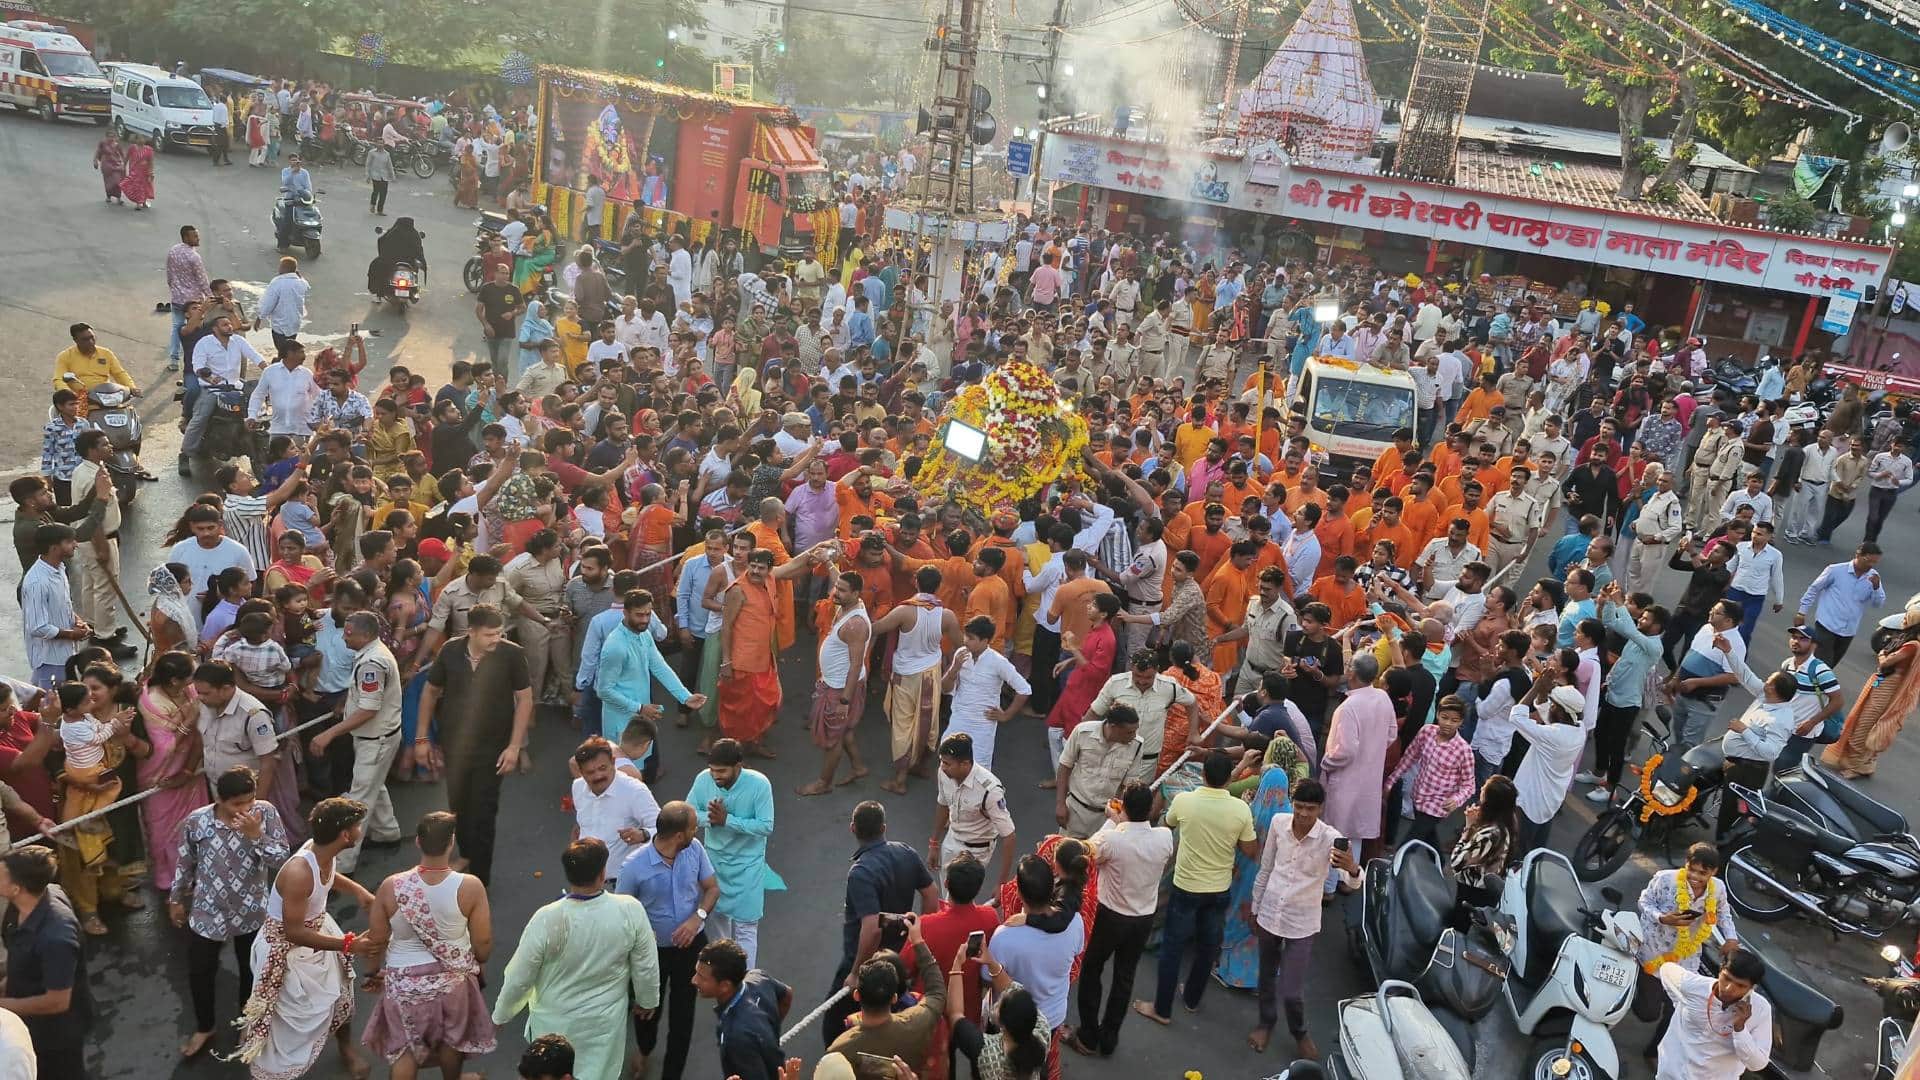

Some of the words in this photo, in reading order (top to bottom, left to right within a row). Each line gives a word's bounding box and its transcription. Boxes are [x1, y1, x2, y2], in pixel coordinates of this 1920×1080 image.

[1289, 178, 1324, 208] श्री
[1327, 183, 1367, 213] माँ
[1368, 191, 1484, 231] छत्रेश्वरी
[1486, 212, 1602, 248] चामुण्डा
[1606, 230, 1683, 261] माता
[1685, 238, 1770, 274] मंदिर
[1864, 374, 1886, 385] POLICE
